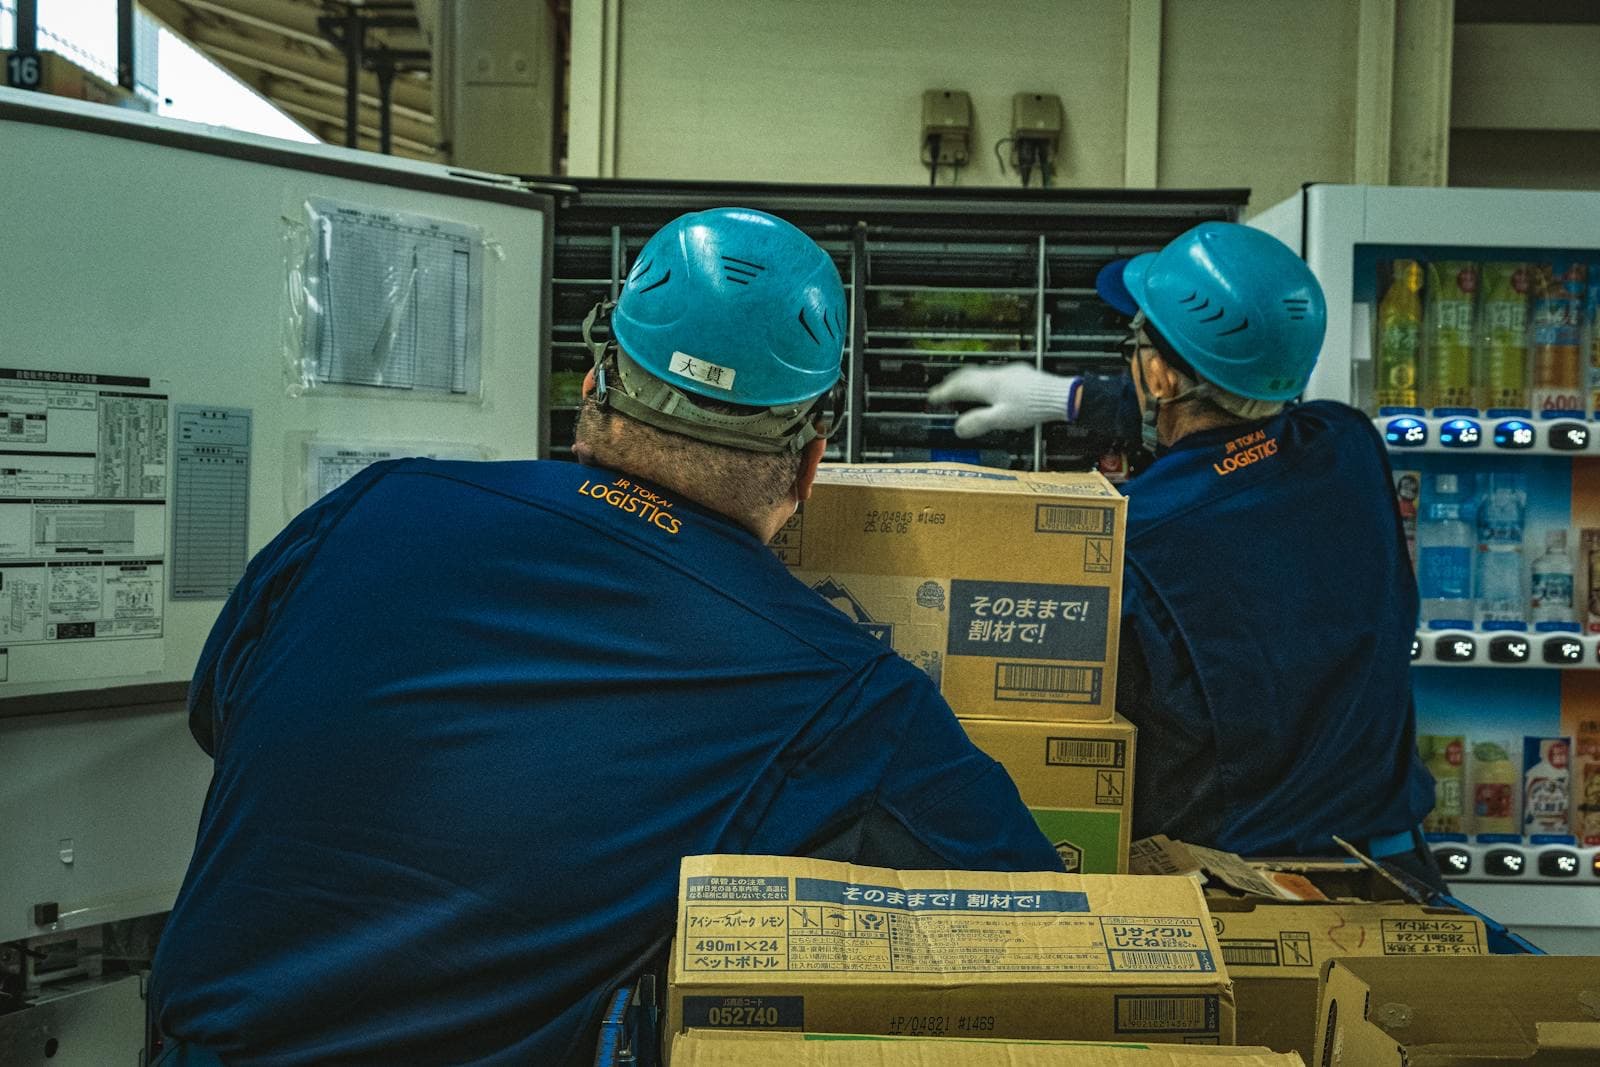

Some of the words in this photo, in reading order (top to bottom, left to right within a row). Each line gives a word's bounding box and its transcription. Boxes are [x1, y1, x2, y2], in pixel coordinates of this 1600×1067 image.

[8, 56, 39, 84] 16
[1213, 438, 1278, 476] LOGISTICS
[612, 477, 631, 490] JR
[633, 484, 674, 508] TOKAI
[577, 479, 684, 535] LOGISTICS
[969, 595, 1090, 622] そのままで!
[967, 619, 1047, 644] 割材で!
[710, 878, 766, 886] 保管上の注意
[842, 886, 957, 907] そのままで!
[966, 893, 1041, 909] 割材で!
[761, 915, 785, 927] レモン
[1395, 921, 1464, 931] ペットボトル
[1112, 926, 1193, 938] リサイクル
[1115, 937, 1160, 948] してね
[694, 956, 780, 969] ペットボトル
[708, 1007, 779, 1026] 052740
[958, 1016, 996, 1031] #1469
